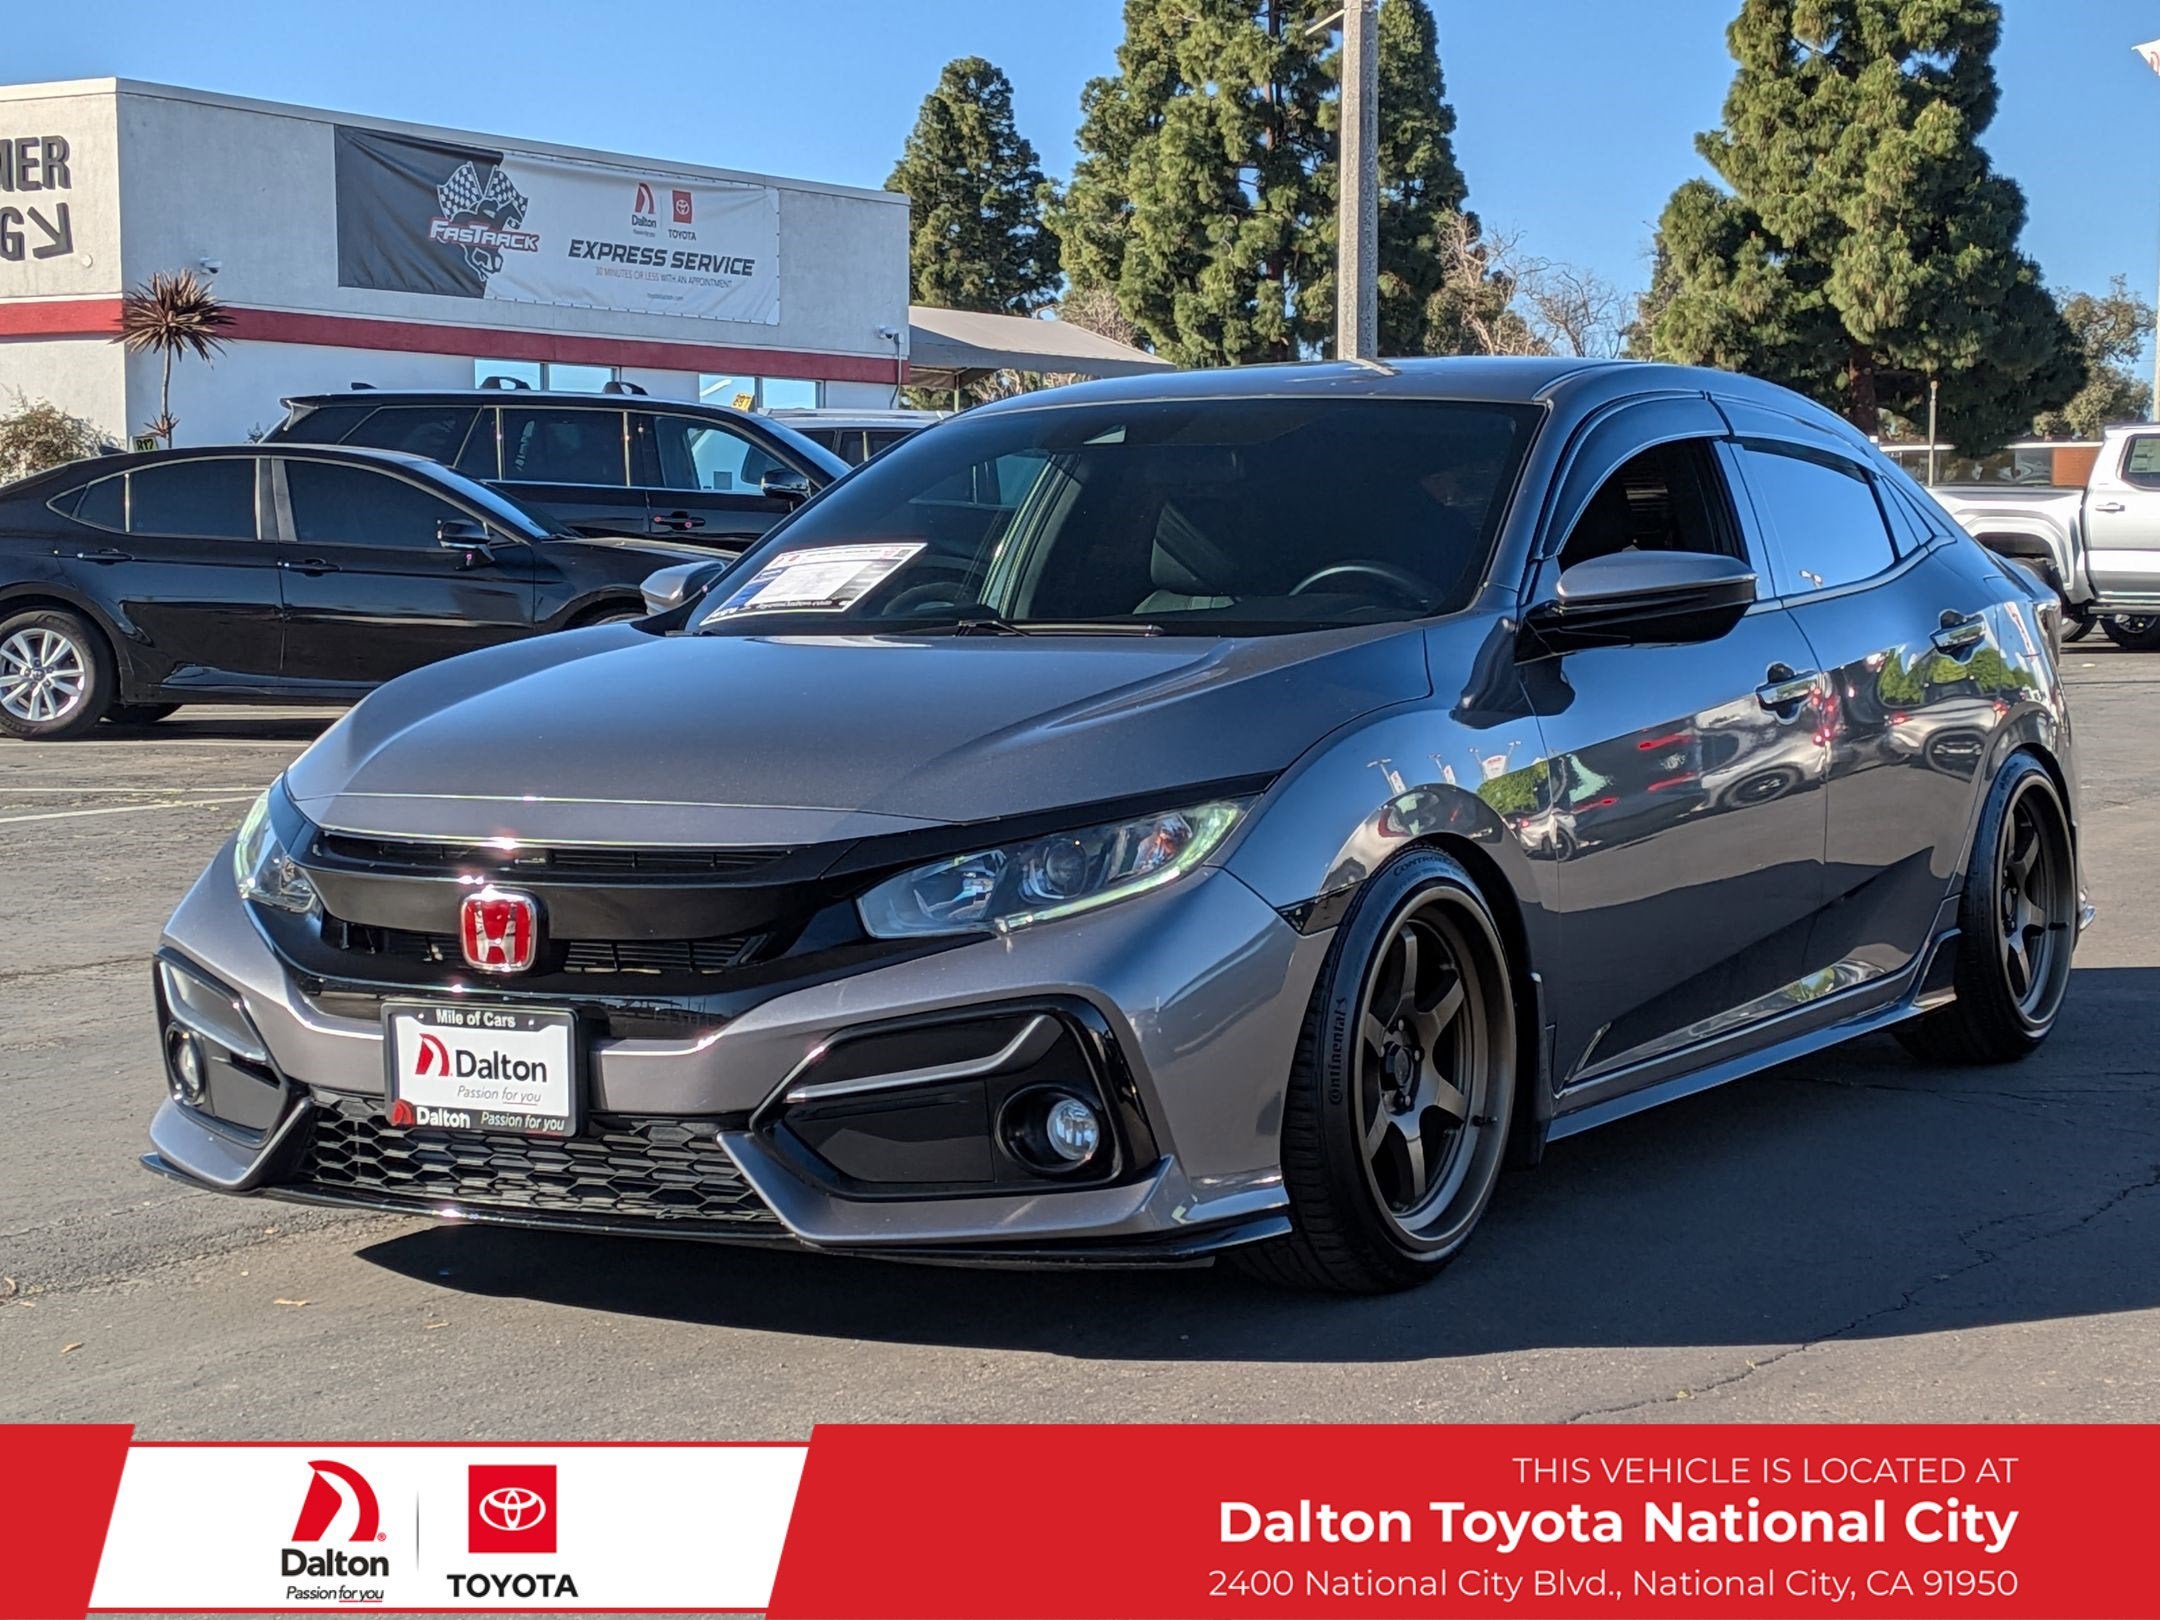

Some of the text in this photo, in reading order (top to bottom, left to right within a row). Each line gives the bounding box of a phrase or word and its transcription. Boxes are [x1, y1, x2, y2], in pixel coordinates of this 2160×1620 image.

[631, 214, 657, 228] Dalton
[668, 229, 697, 241] TOYOTA
[568, 239, 755, 276] EXPRESS SERVICE
[634, 270, 644, 280] OR
[645, 271, 660, 282] LESS
[677, 275, 688, 285] AN
[435, 1009, 516, 1028] Mile of Cars
[456, 1049, 547, 1083] Dalton
[457, 1085, 542, 1105] Passion for you
[416, 1107, 565, 1132] Dalton Passion for you
